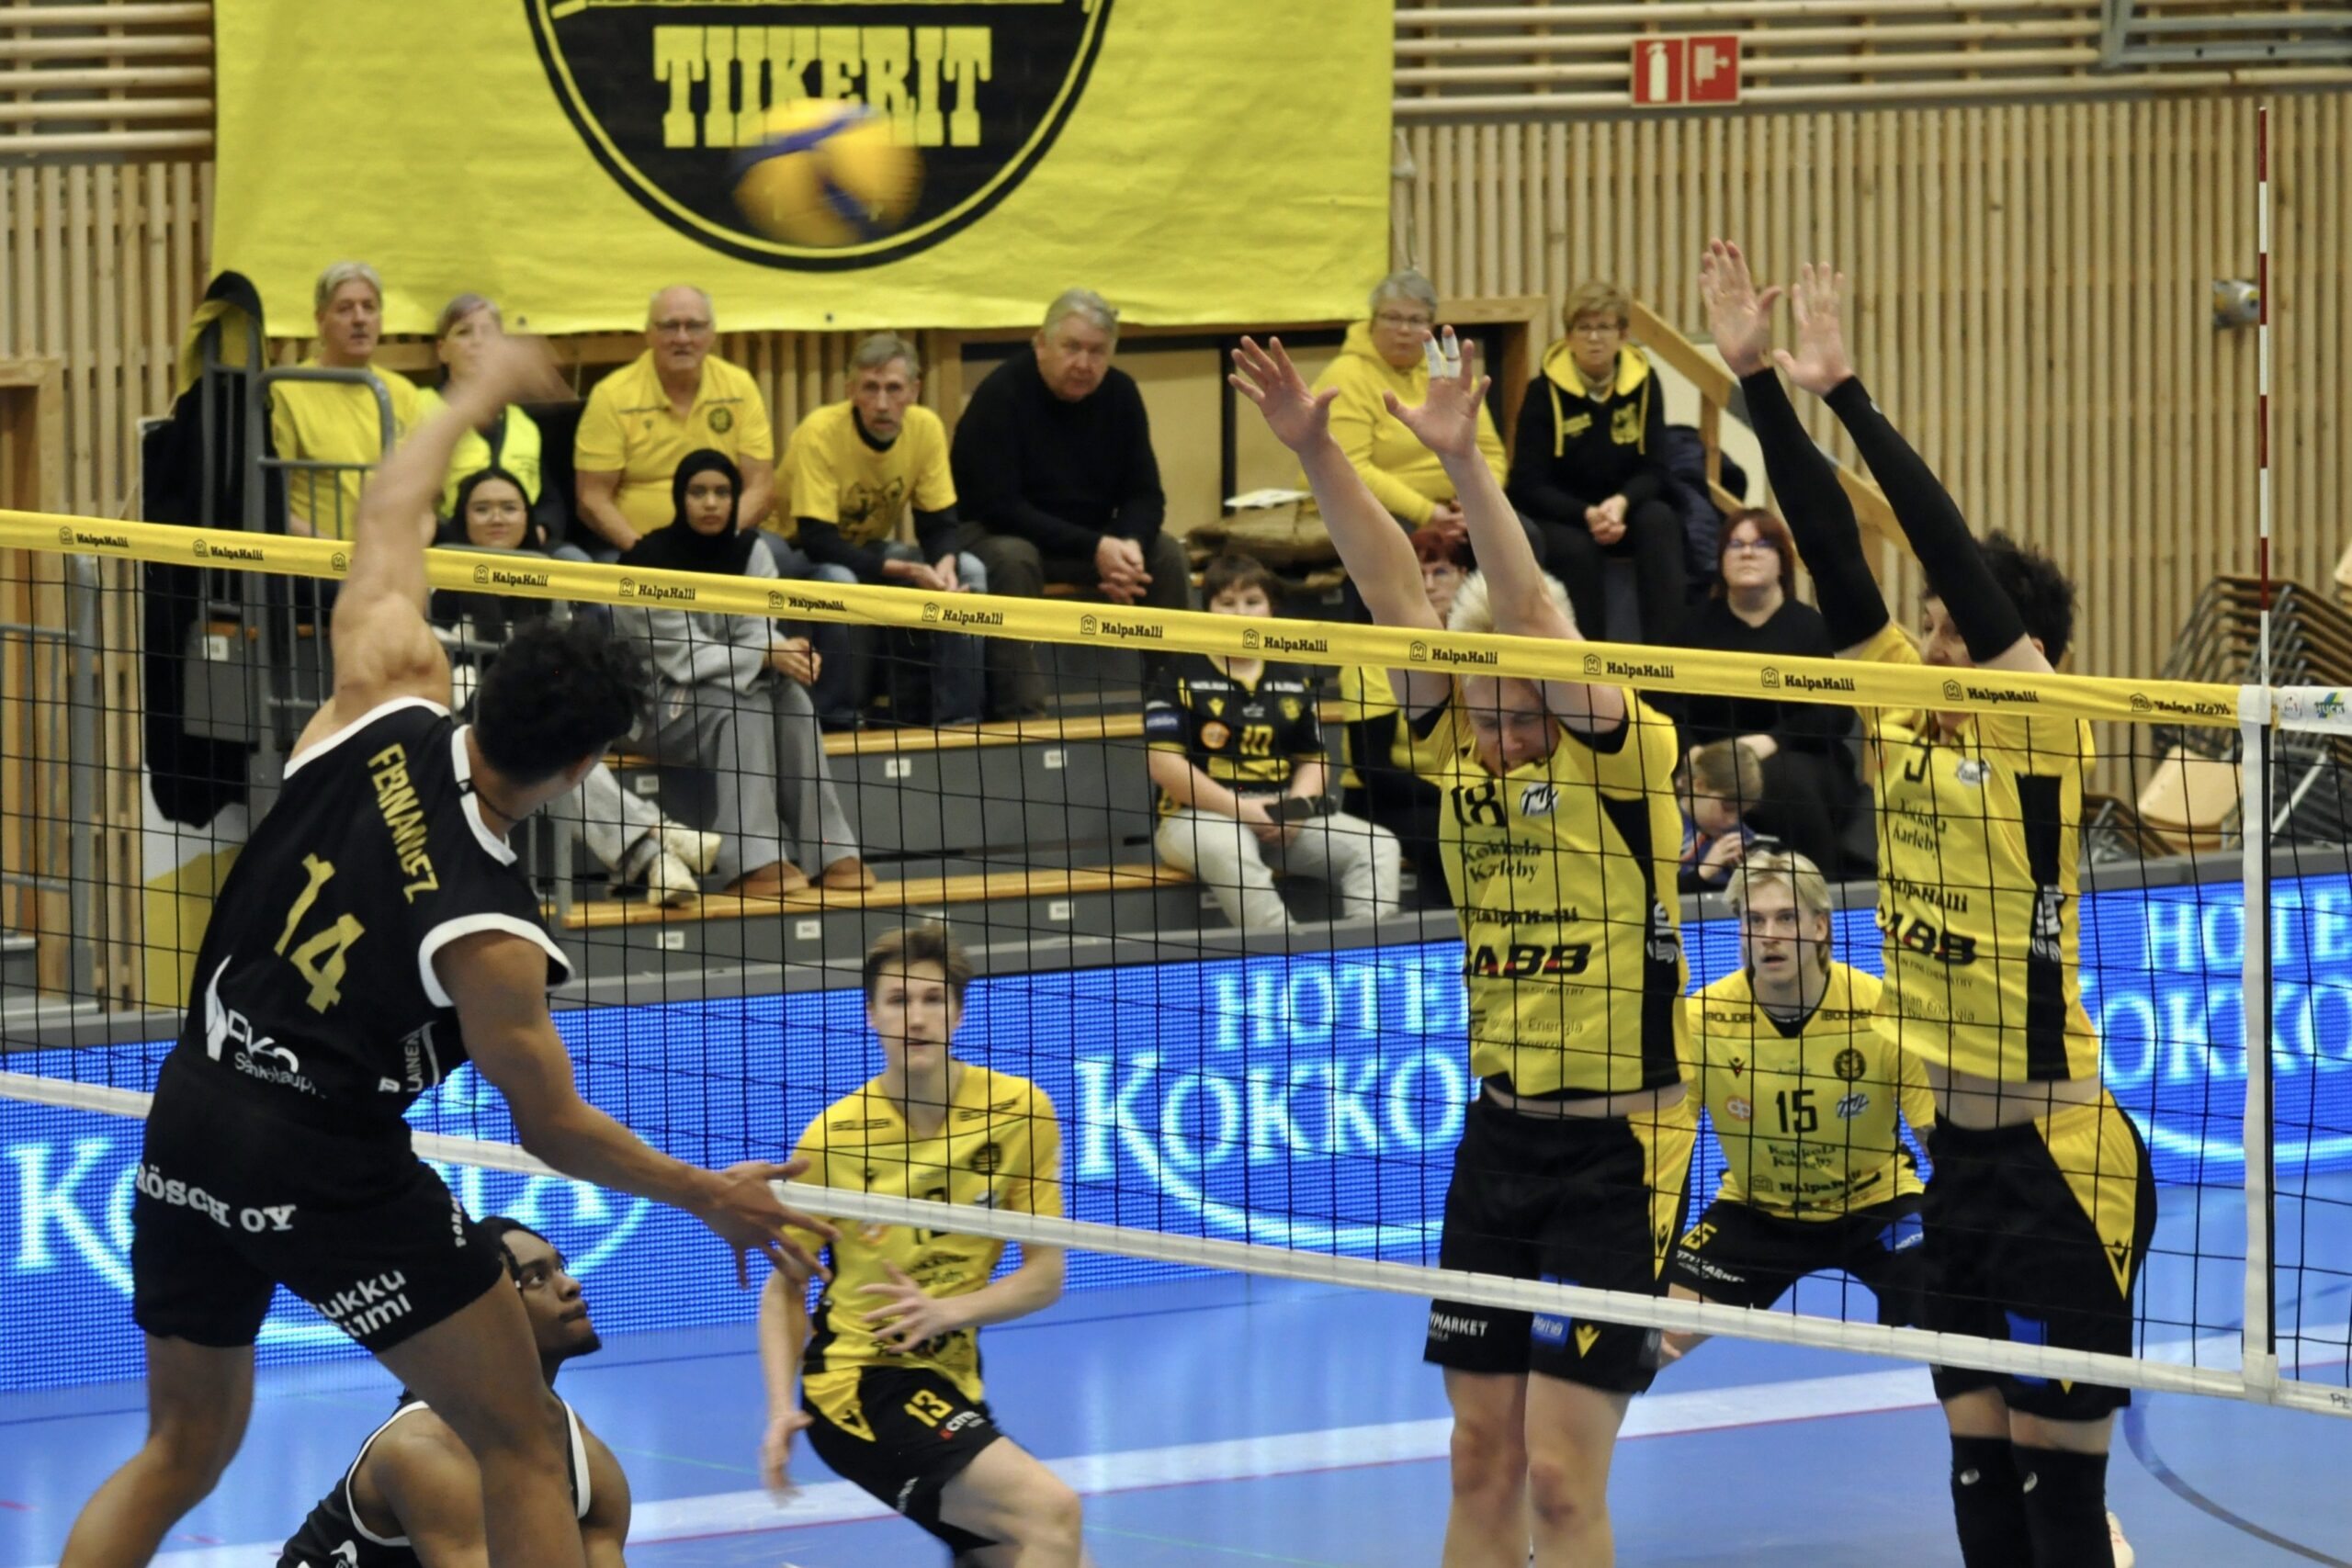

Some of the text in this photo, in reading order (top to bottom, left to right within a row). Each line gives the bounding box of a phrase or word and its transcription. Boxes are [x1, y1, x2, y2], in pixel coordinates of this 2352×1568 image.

[653, 26, 991, 147] TIIKERIT
[492, 570, 549, 588] HalpaHalli
[639, 584, 696, 601] HalpaHalli
[788, 596, 847, 613] HalpaHalli
[942, 609, 1003, 626] HalpaHalli
[1101, 621, 1163, 639] HalpaHalli
[1264, 636, 1329, 654] HalpaHalli
[1431, 648, 1498, 665] HalpaHalli
[1606, 661, 1674, 679] HalpaHalli
[1784, 674, 1855, 692] HalpaHalli
[1967, 686, 2040, 704] HalpaHalli
[274, 852, 366, 1014] 14
[1473, 942, 1591, 977] ABB
[1216, 957, 1467, 1053] HOTE
[2078, 972, 2352, 1089] OKKO
[1075, 1045, 1482, 1179] KOKKO
[1775, 1089, 1819, 1134] 15
[135, 1163, 297, 1233] RÖSCH OY
[315, 1269, 407, 1320] ukku
[903, 1388, 954, 1427] 13
